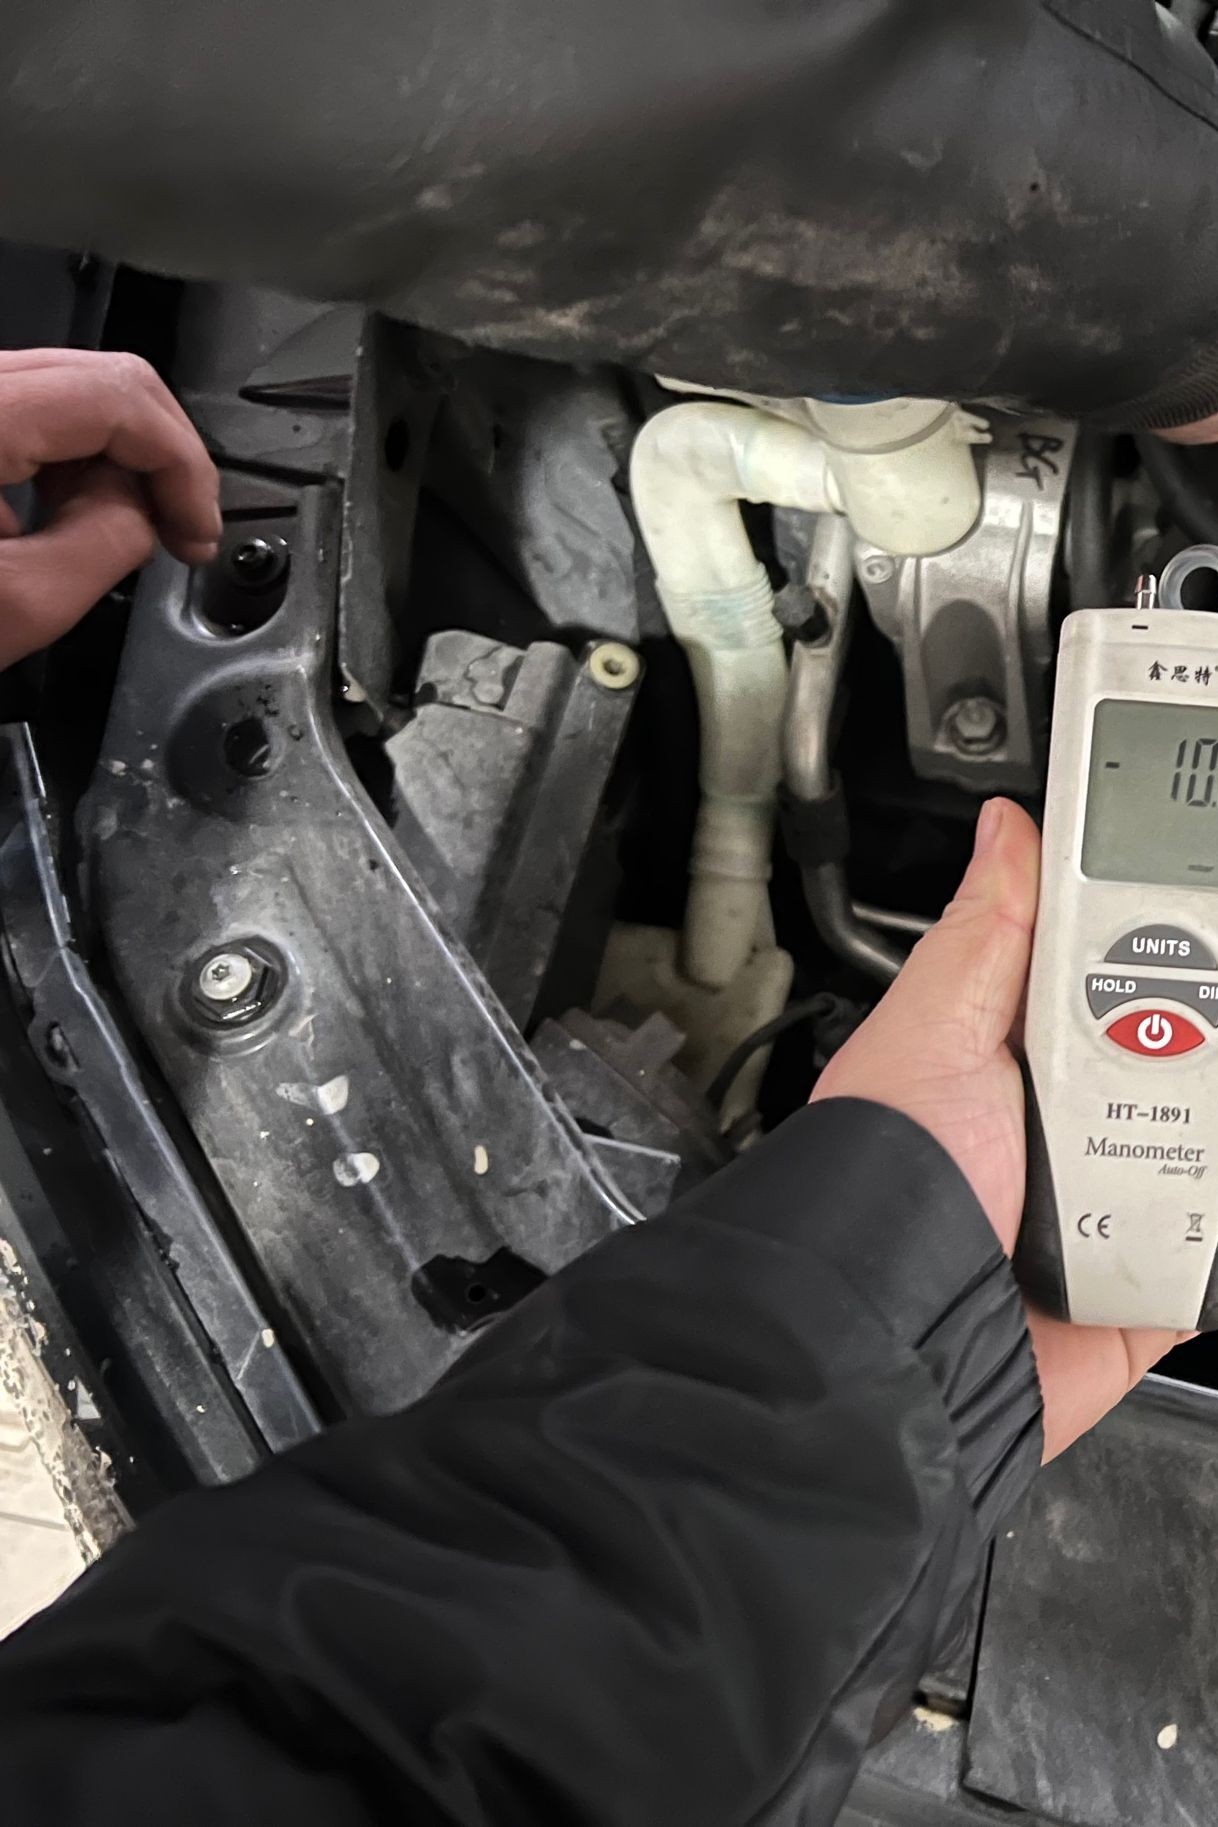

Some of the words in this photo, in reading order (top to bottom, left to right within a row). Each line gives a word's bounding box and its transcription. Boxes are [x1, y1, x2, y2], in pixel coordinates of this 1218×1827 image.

[1132, 937, 1191, 957] UNITS
[1092, 978, 1137, 994] HOLD
[1106, 1102, 1191, 1124] HT-1891
[1085, 1136, 1205, 1162] Manometer
[1158, 1163, 1208, 1180] Auto-Off
